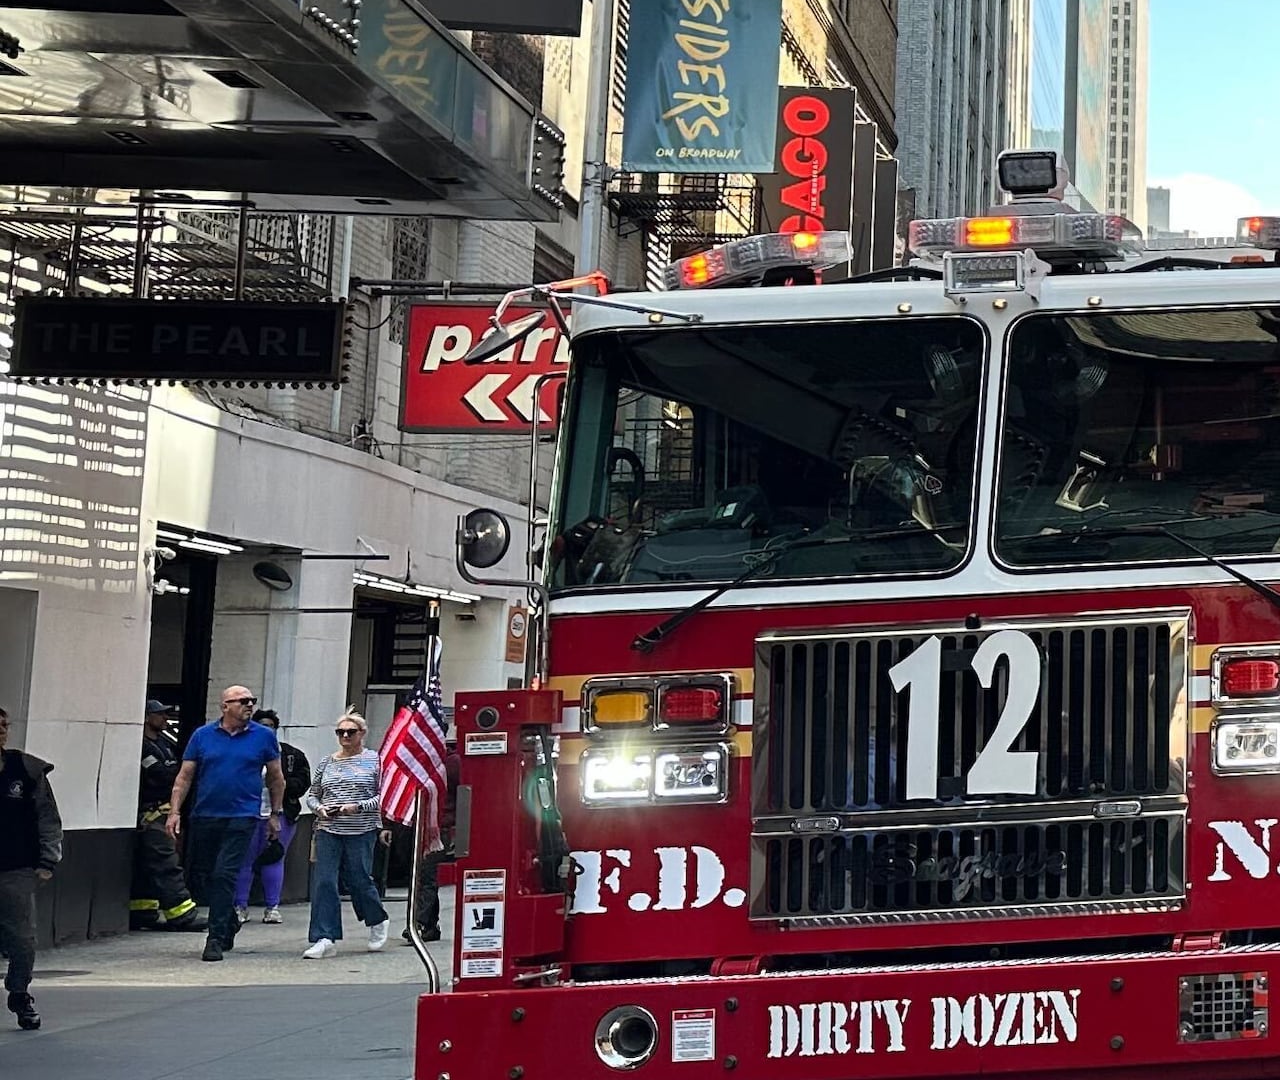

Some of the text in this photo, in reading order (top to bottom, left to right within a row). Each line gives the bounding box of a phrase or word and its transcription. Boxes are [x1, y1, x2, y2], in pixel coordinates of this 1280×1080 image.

[656, 147, 742, 159] ON BROADWAY
[35, 322, 321, 357] THE PEARL
[888, 628, 1042, 802] 12
[569, 846, 747, 915] F.D.
[767, 998, 912, 1059] DIRTY
[930, 989, 1081, 1051] DOZEN
